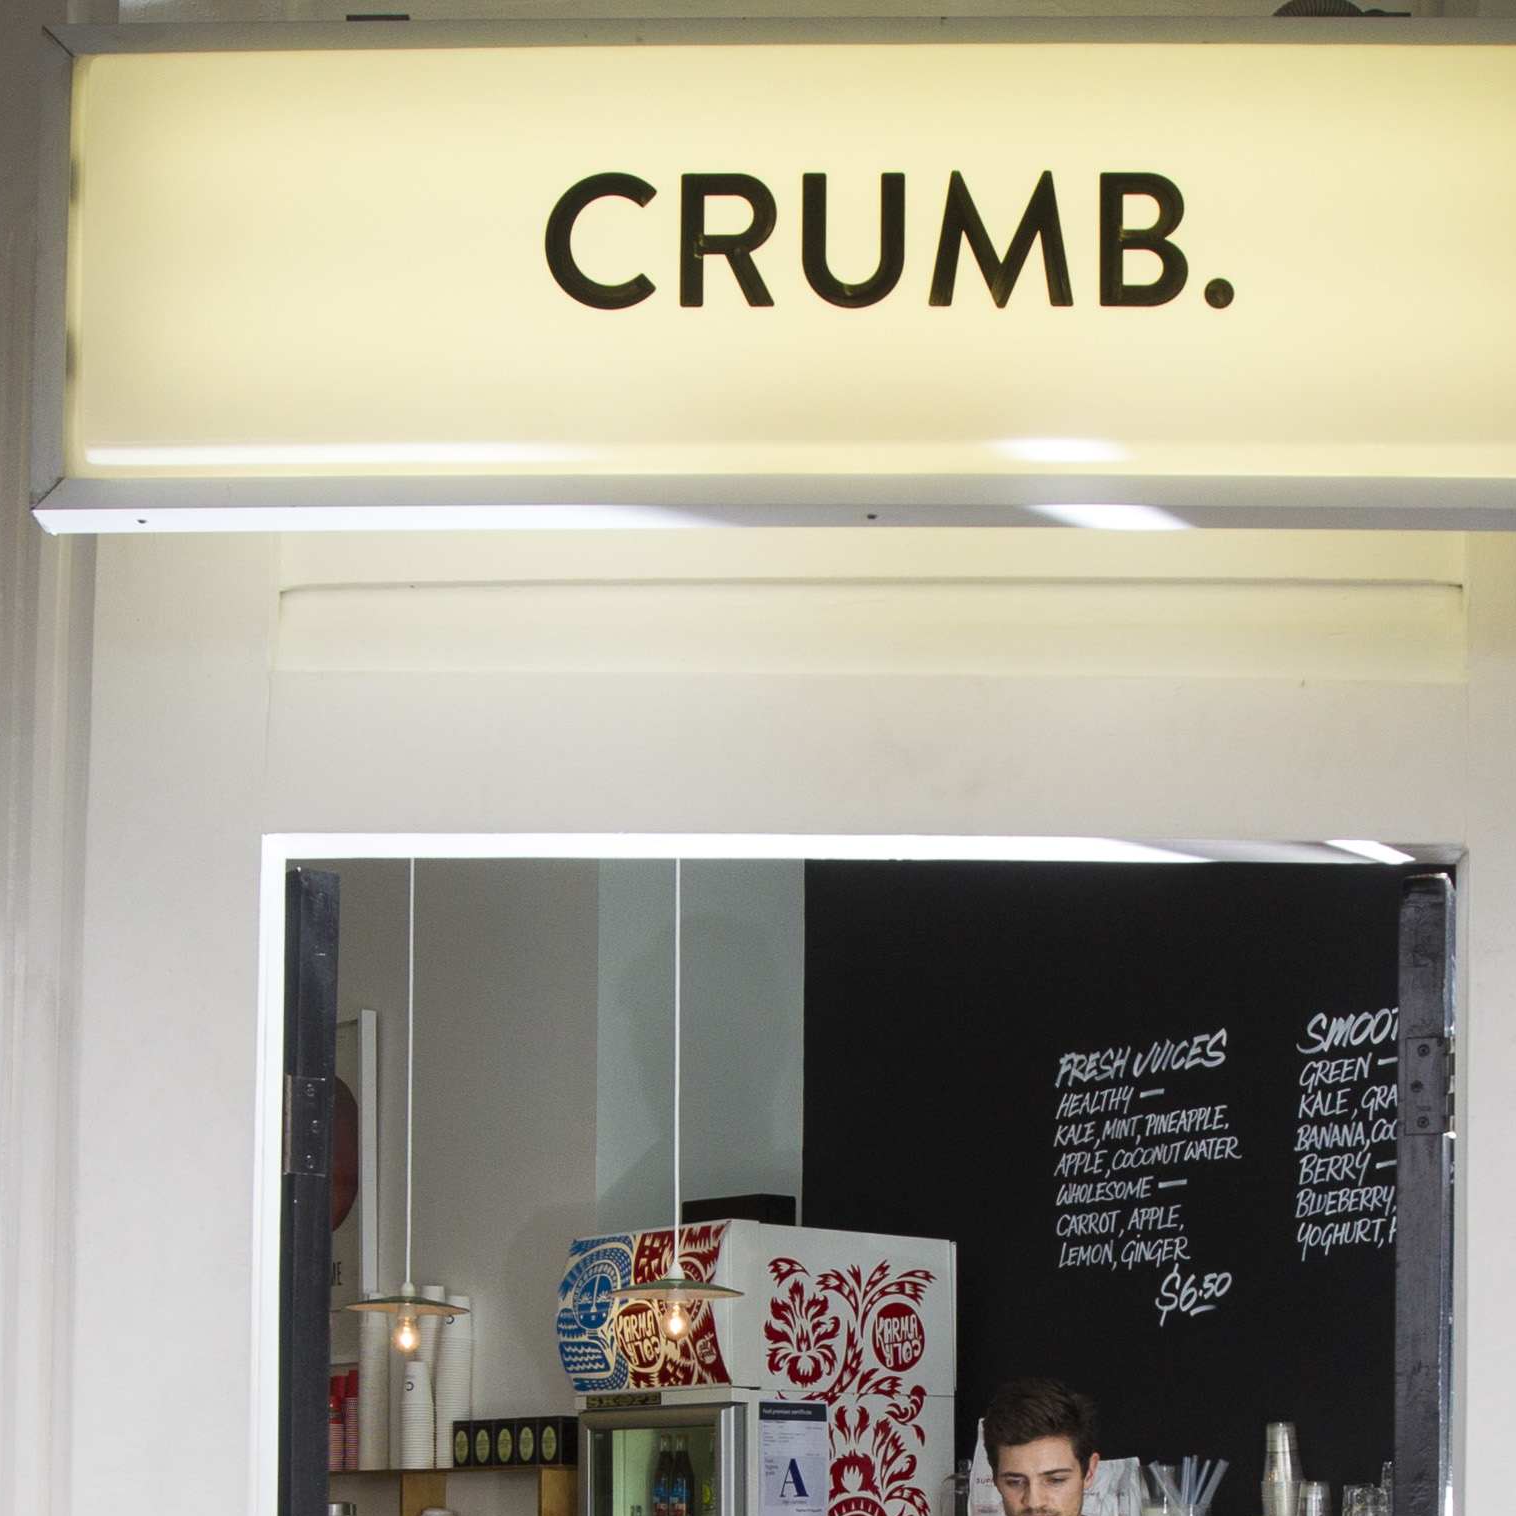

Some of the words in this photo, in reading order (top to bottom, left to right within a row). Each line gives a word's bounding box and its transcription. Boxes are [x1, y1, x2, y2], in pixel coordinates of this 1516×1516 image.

[544, 169, 1235, 310] CRUMB.
[1055, 1046, 1131, 1088] FRESH
[1133, 1028, 1227, 1078] JUICES
[1299, 1052, 1372, 1094] GREEN
[1055, 1085, 1134, 1120] HEALTHY
[1298, 1088, 1357, 1120] KALE,
[1053, 1121, 1101, 1150] KALE,
[1102, 1114, 1143, 1145] MINT,
[1294, 1121, 1370, 1152] BANANA,
[1054, 1150, 1111, 1179] APPLE,
[1112, 1140, 1186, 1170] COCONUT
[1184, 1136, 1242, 1161] WATER
[1299, 1151, 1371, 1187] BERRY
[1055, 1176, 1154, 1206] WHOLESOME
[1056, 1210, 1124, 1238] CARROT,
[1128, 1204, 1184, 1232] APPLE,
[1058, 1239, 1117, 1271] LEMON,
[1121, 1234, 1190, 1270] GINGER
[1297, 1218, 1387, 1262] YOGHURT,
[1155, 1263, 1232, 1326] $6.50
[616, 1308, 656, 1344] KARMA
[875, 1313, 918, 1348] KARMA
[885, 1339, 922, 1368] COLA
[780, 1458, 810, 1497] A
